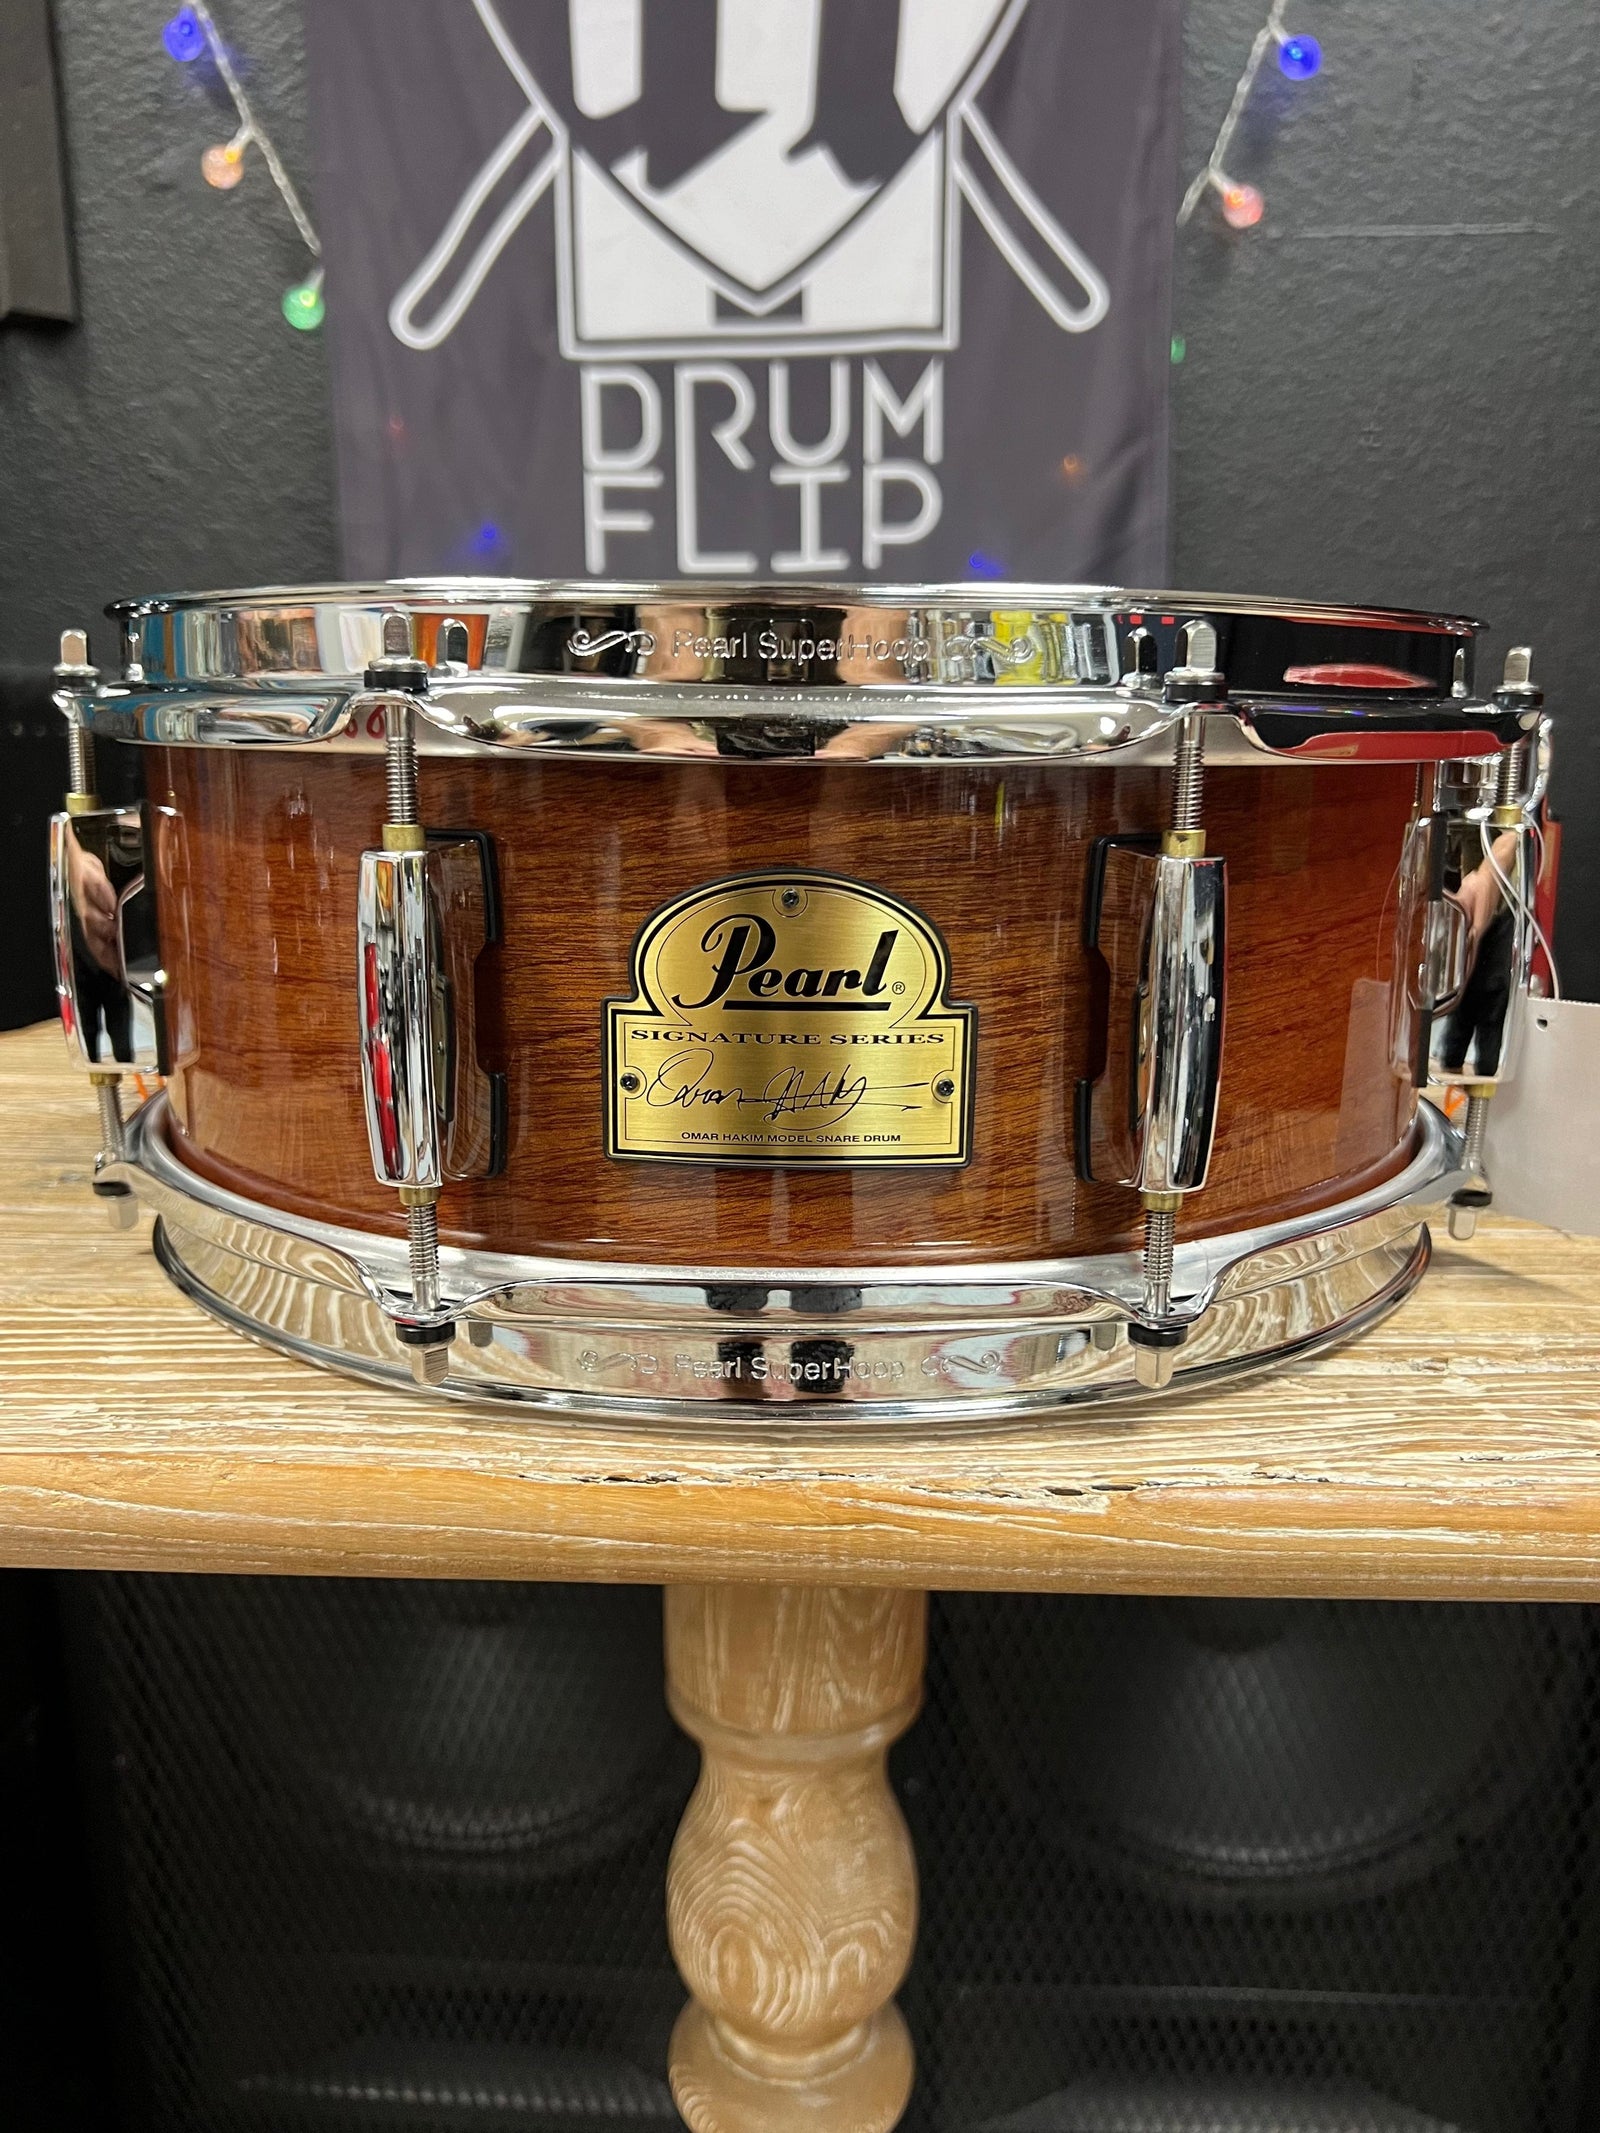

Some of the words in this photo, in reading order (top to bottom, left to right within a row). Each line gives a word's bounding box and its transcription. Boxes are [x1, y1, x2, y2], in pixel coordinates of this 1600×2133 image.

[580, 356, 944, 470] DRUM
[583, 458, 943, 575] FLIP
[671, 628, 748, 659] Pearl
[631, 1029, 821, 1045] SIGNATURE
[829, 1033, 945, 1045] SERIES
[681, 1131, 719, 1141] OMAR
[722, 1133, 764, 1143] HAKIM
[767, 1133, 813, 1143] MODEL
[815, 1134, 861, 1143] SNARE
[863, 1134, 901, 1143] DRUM
[673, 1353, 742, 1379] Pearl
